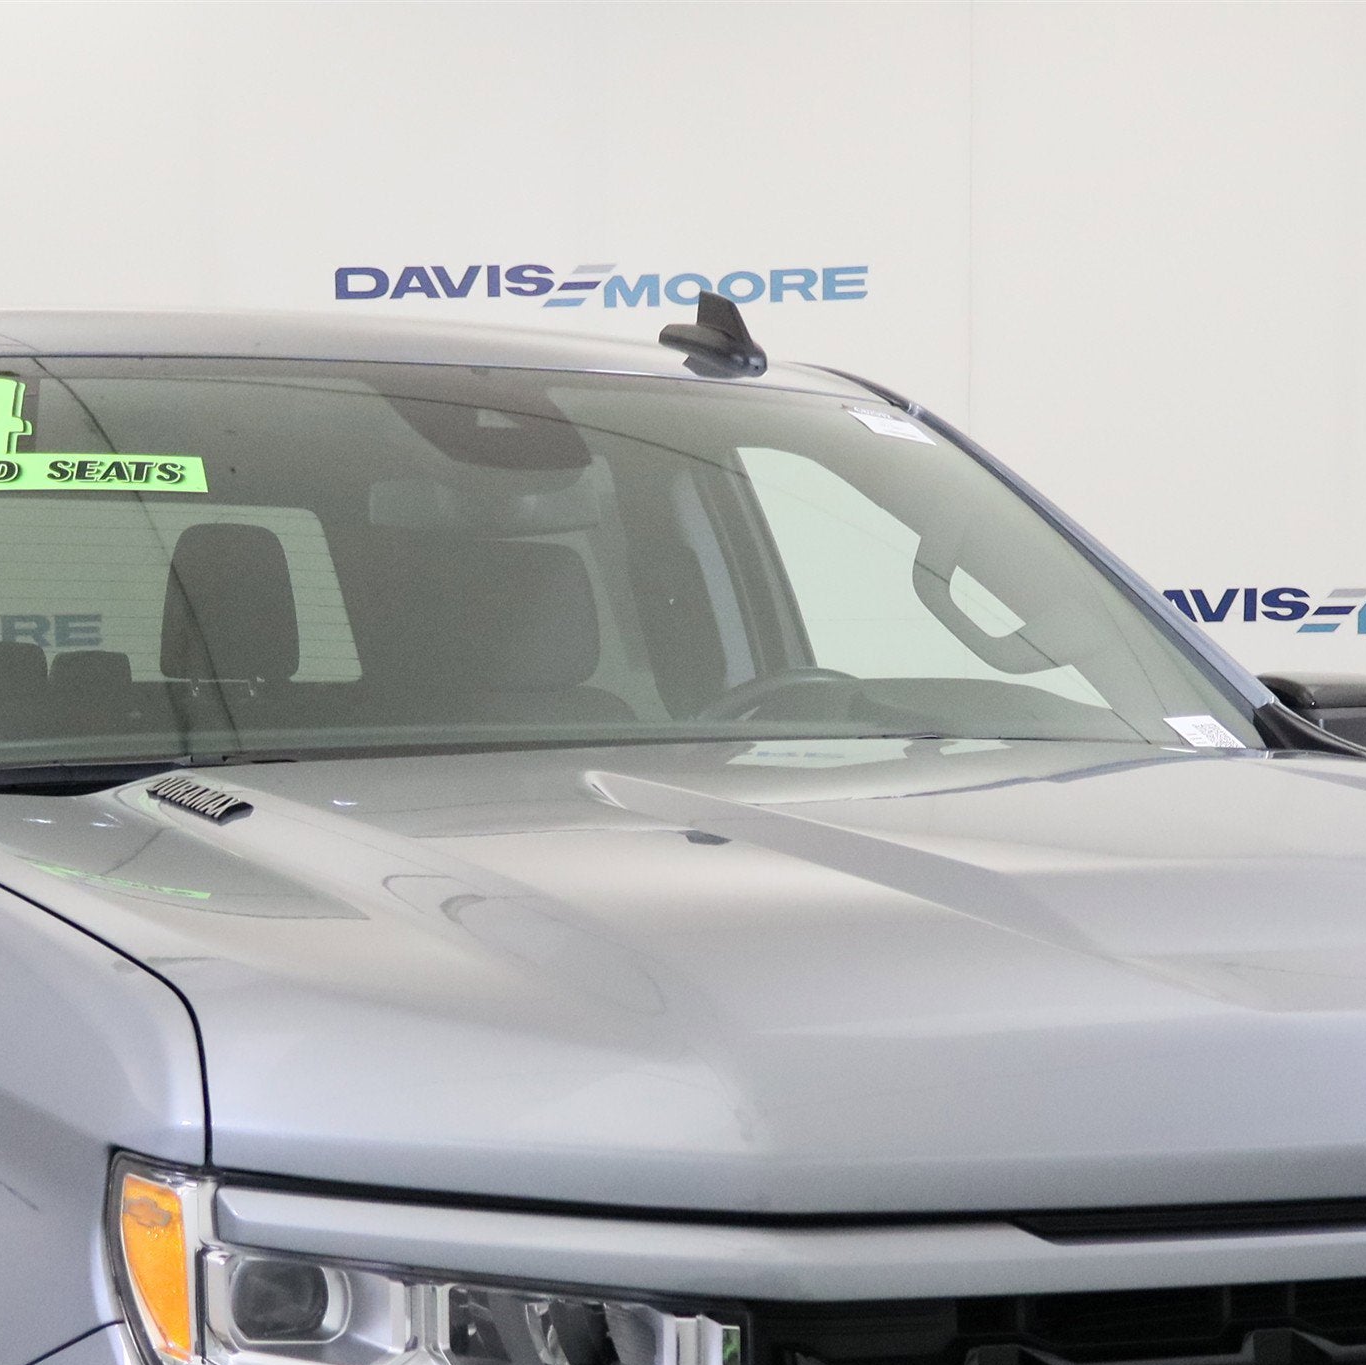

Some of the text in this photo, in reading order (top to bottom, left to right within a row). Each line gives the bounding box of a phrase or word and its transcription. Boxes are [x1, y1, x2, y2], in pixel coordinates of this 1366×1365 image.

[334, 264, 869, 308] DAVIS MOORE
[47, 459, 186, 485] SEATS
[1163, 587, 1311, 623] AVIS
